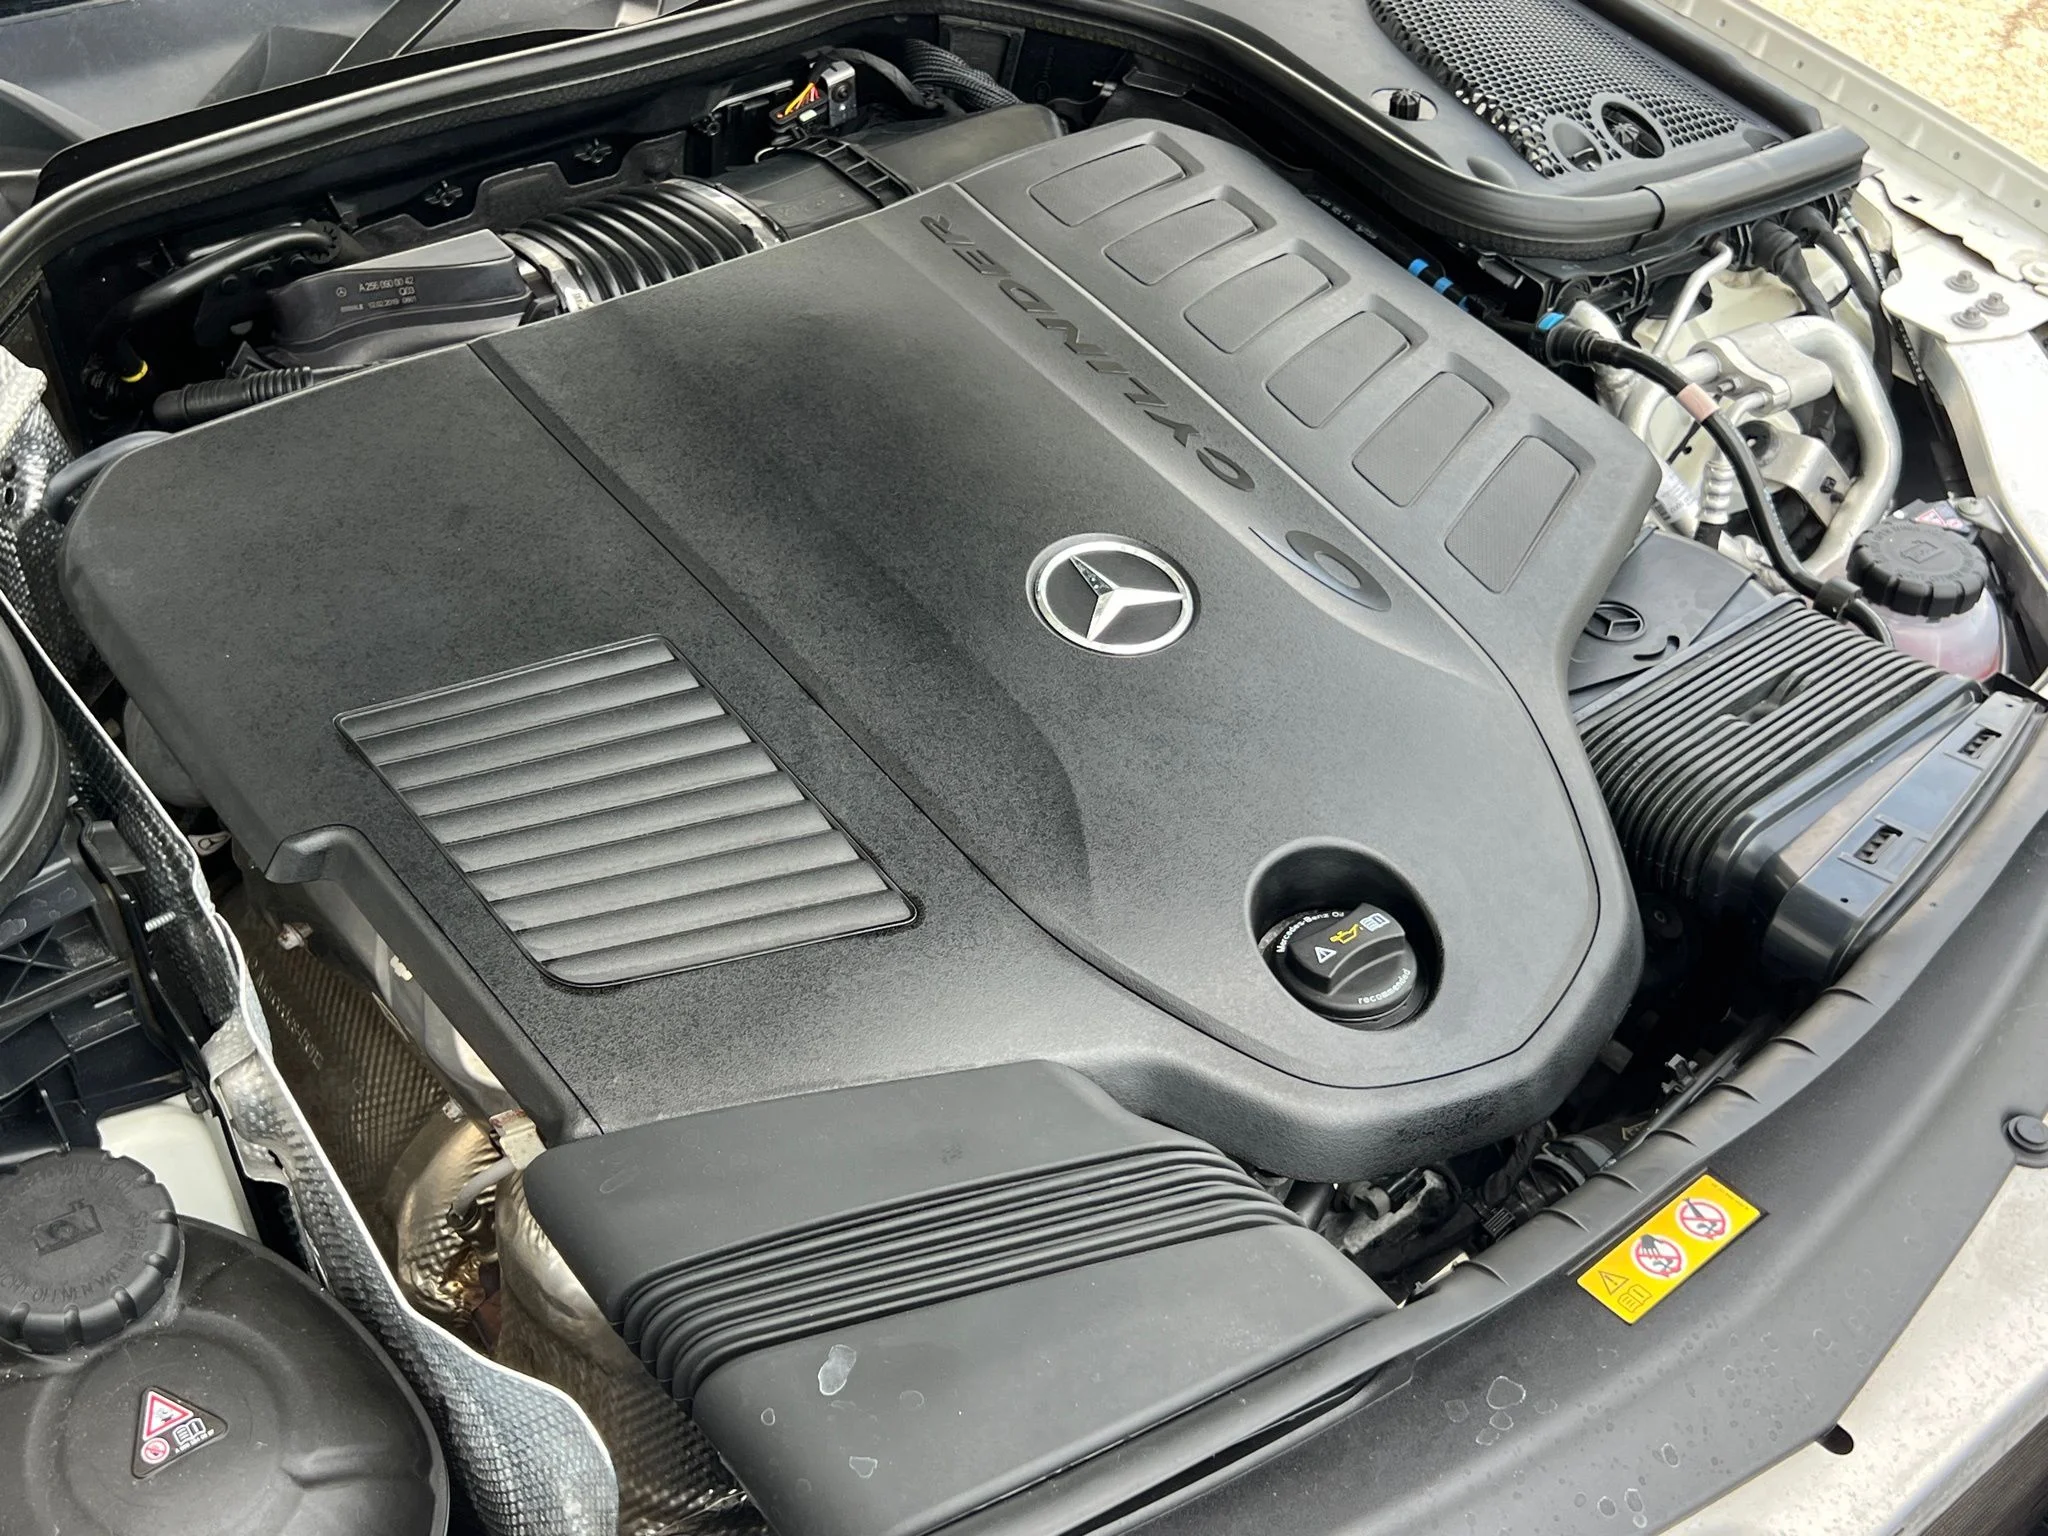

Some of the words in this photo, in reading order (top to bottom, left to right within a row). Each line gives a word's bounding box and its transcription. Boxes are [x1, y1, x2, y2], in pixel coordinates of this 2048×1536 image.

[920, 214, 1255, 492] CYLINDER
[1276, 912, 1329, 953] Mercedes-Benz
[1358, 968, 1411, 1004] recommended
